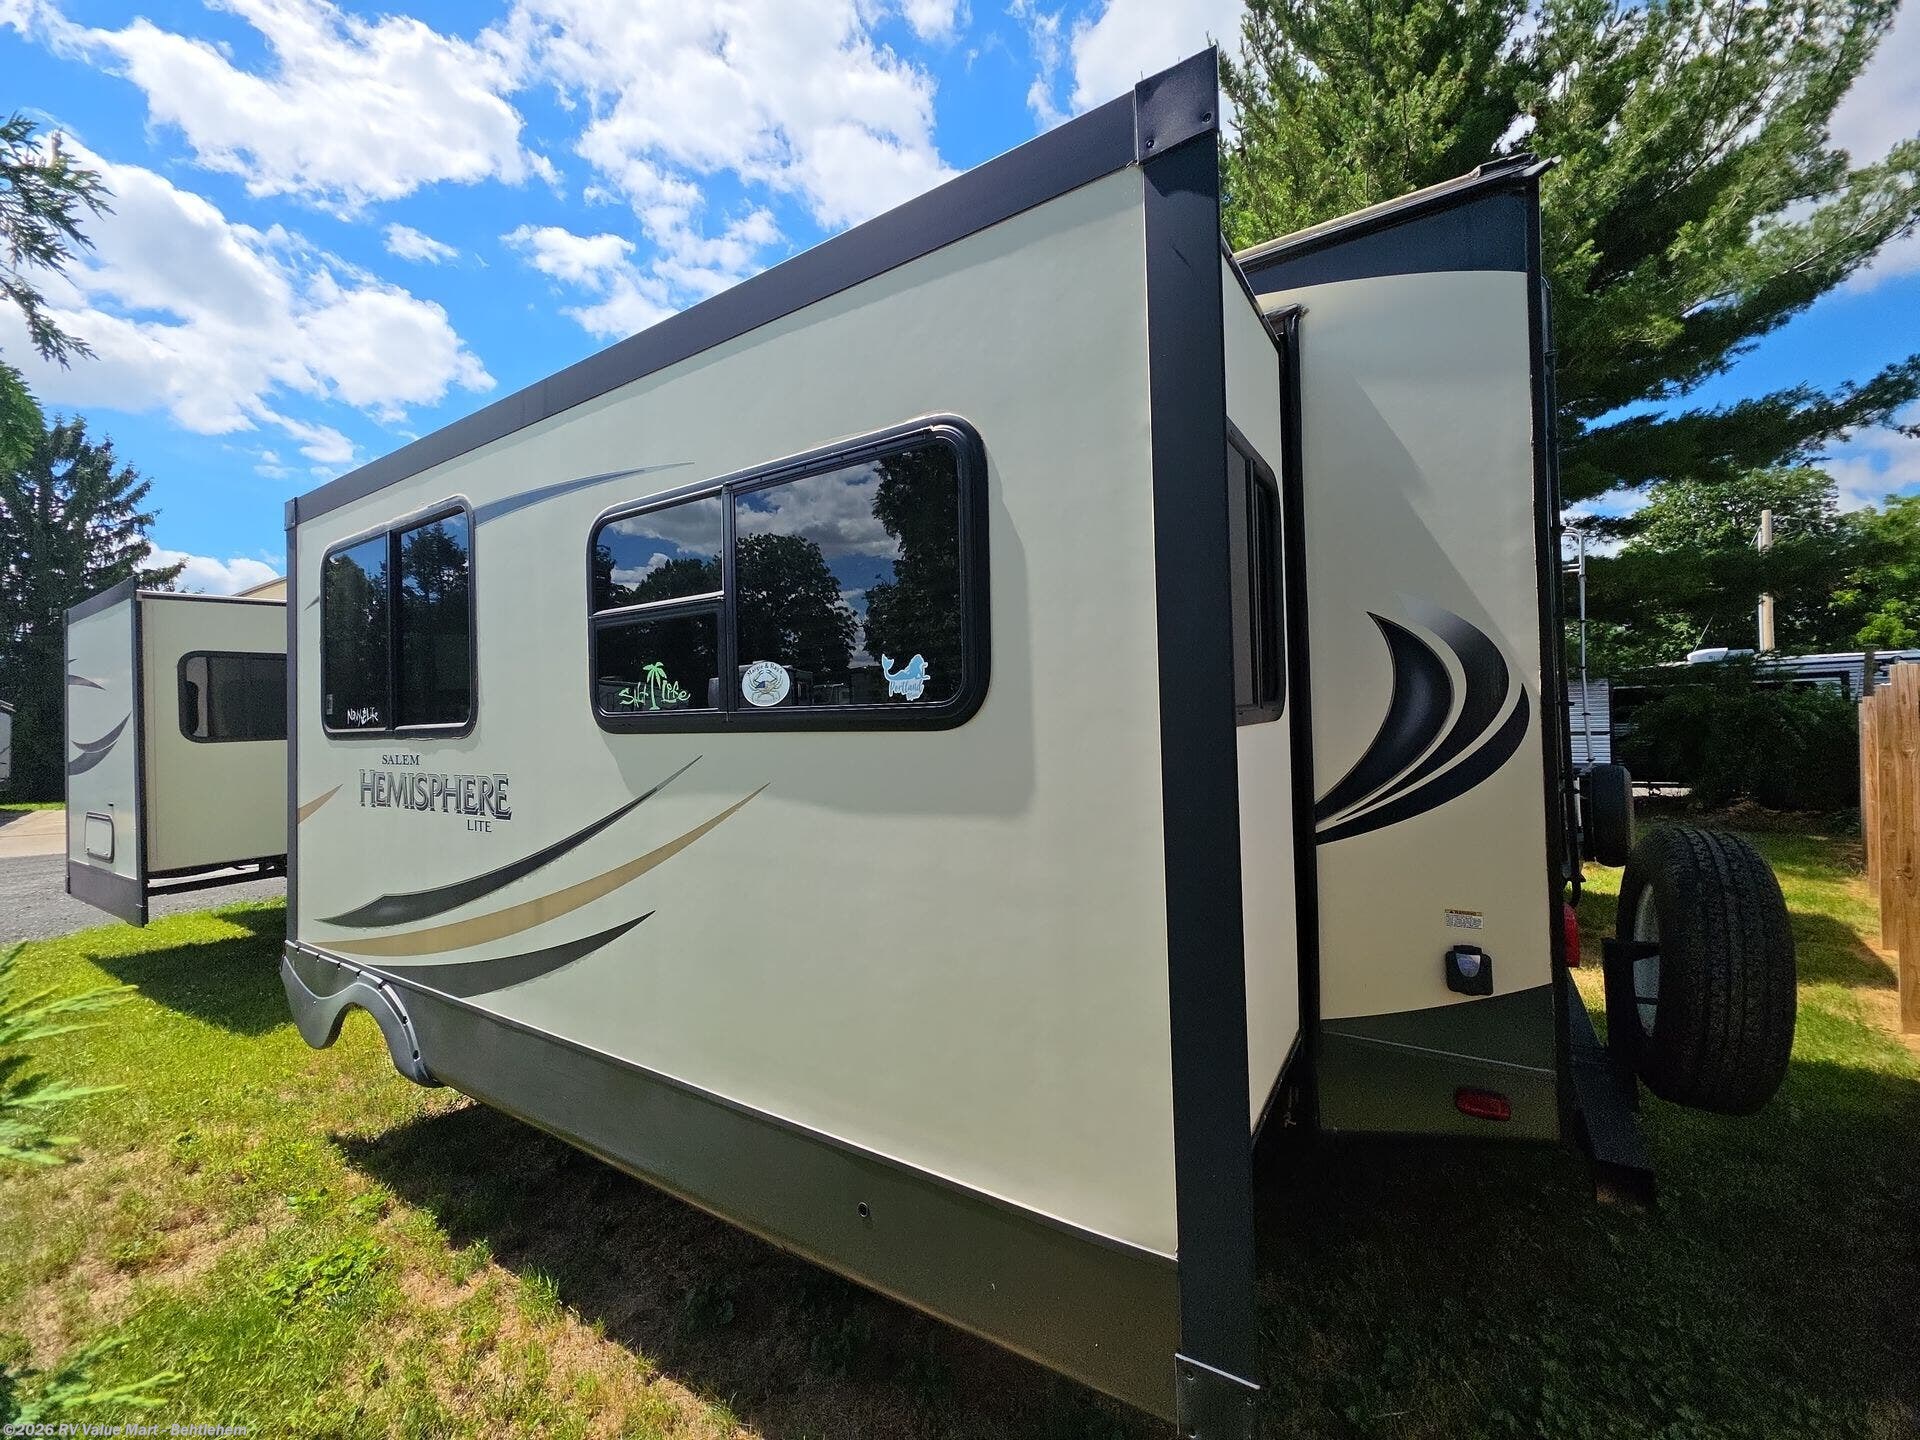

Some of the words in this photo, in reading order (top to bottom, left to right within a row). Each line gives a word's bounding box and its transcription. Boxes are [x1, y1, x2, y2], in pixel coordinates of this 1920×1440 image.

[661, 680, 691, 703] Life
[382, 754, 420, 766] SALEM
[359, 769, 512, 820] HEMISPHERE
[467, 819, 492, 833] LITE
